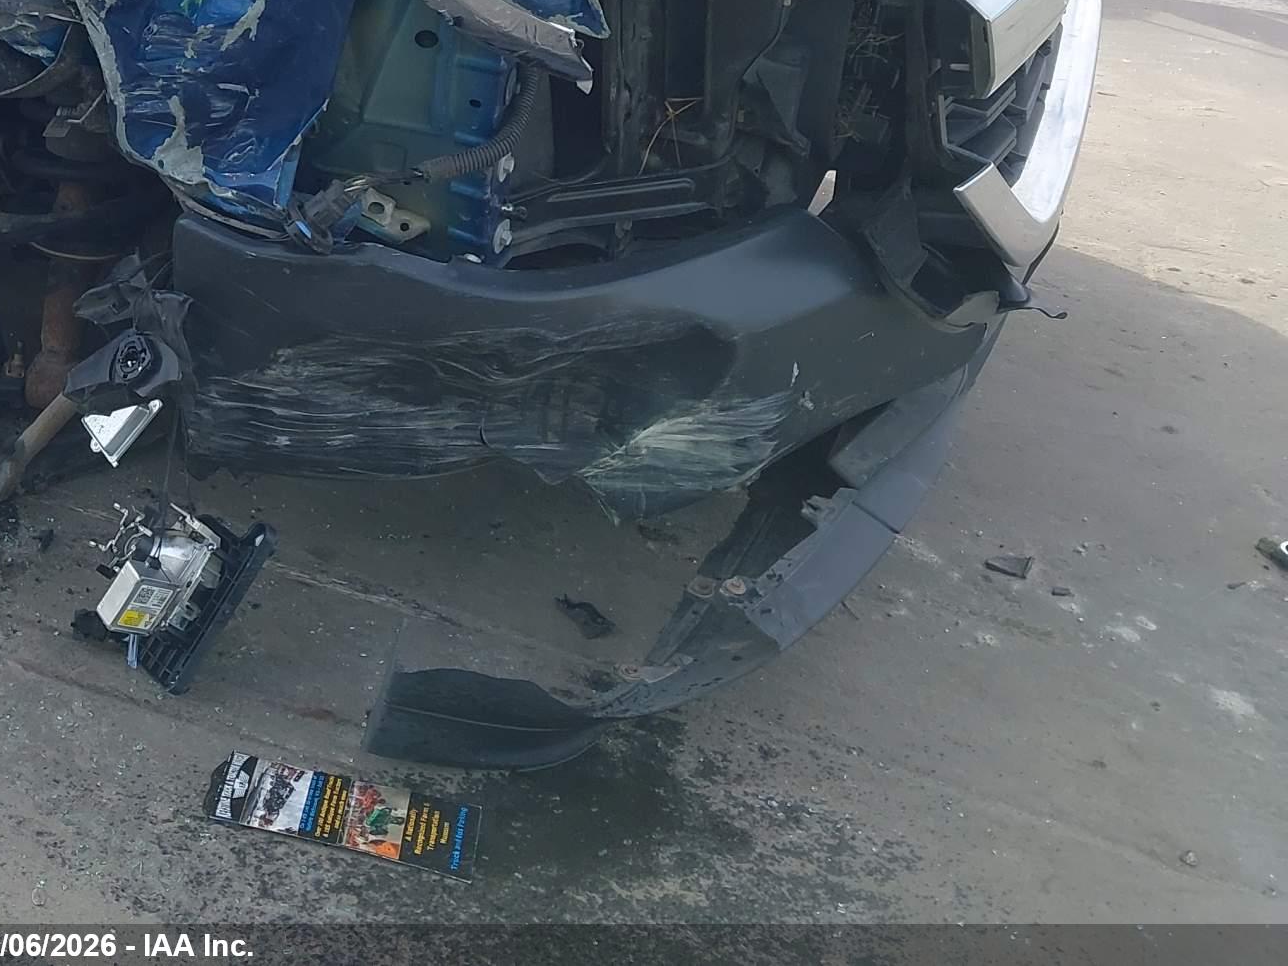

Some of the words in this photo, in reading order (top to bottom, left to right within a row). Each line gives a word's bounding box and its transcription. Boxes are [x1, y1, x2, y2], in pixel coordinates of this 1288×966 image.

[456, 806, 468, 827] Parking
[452, 838, 461, 850] and
[450, 849, 460, 870] Truck
